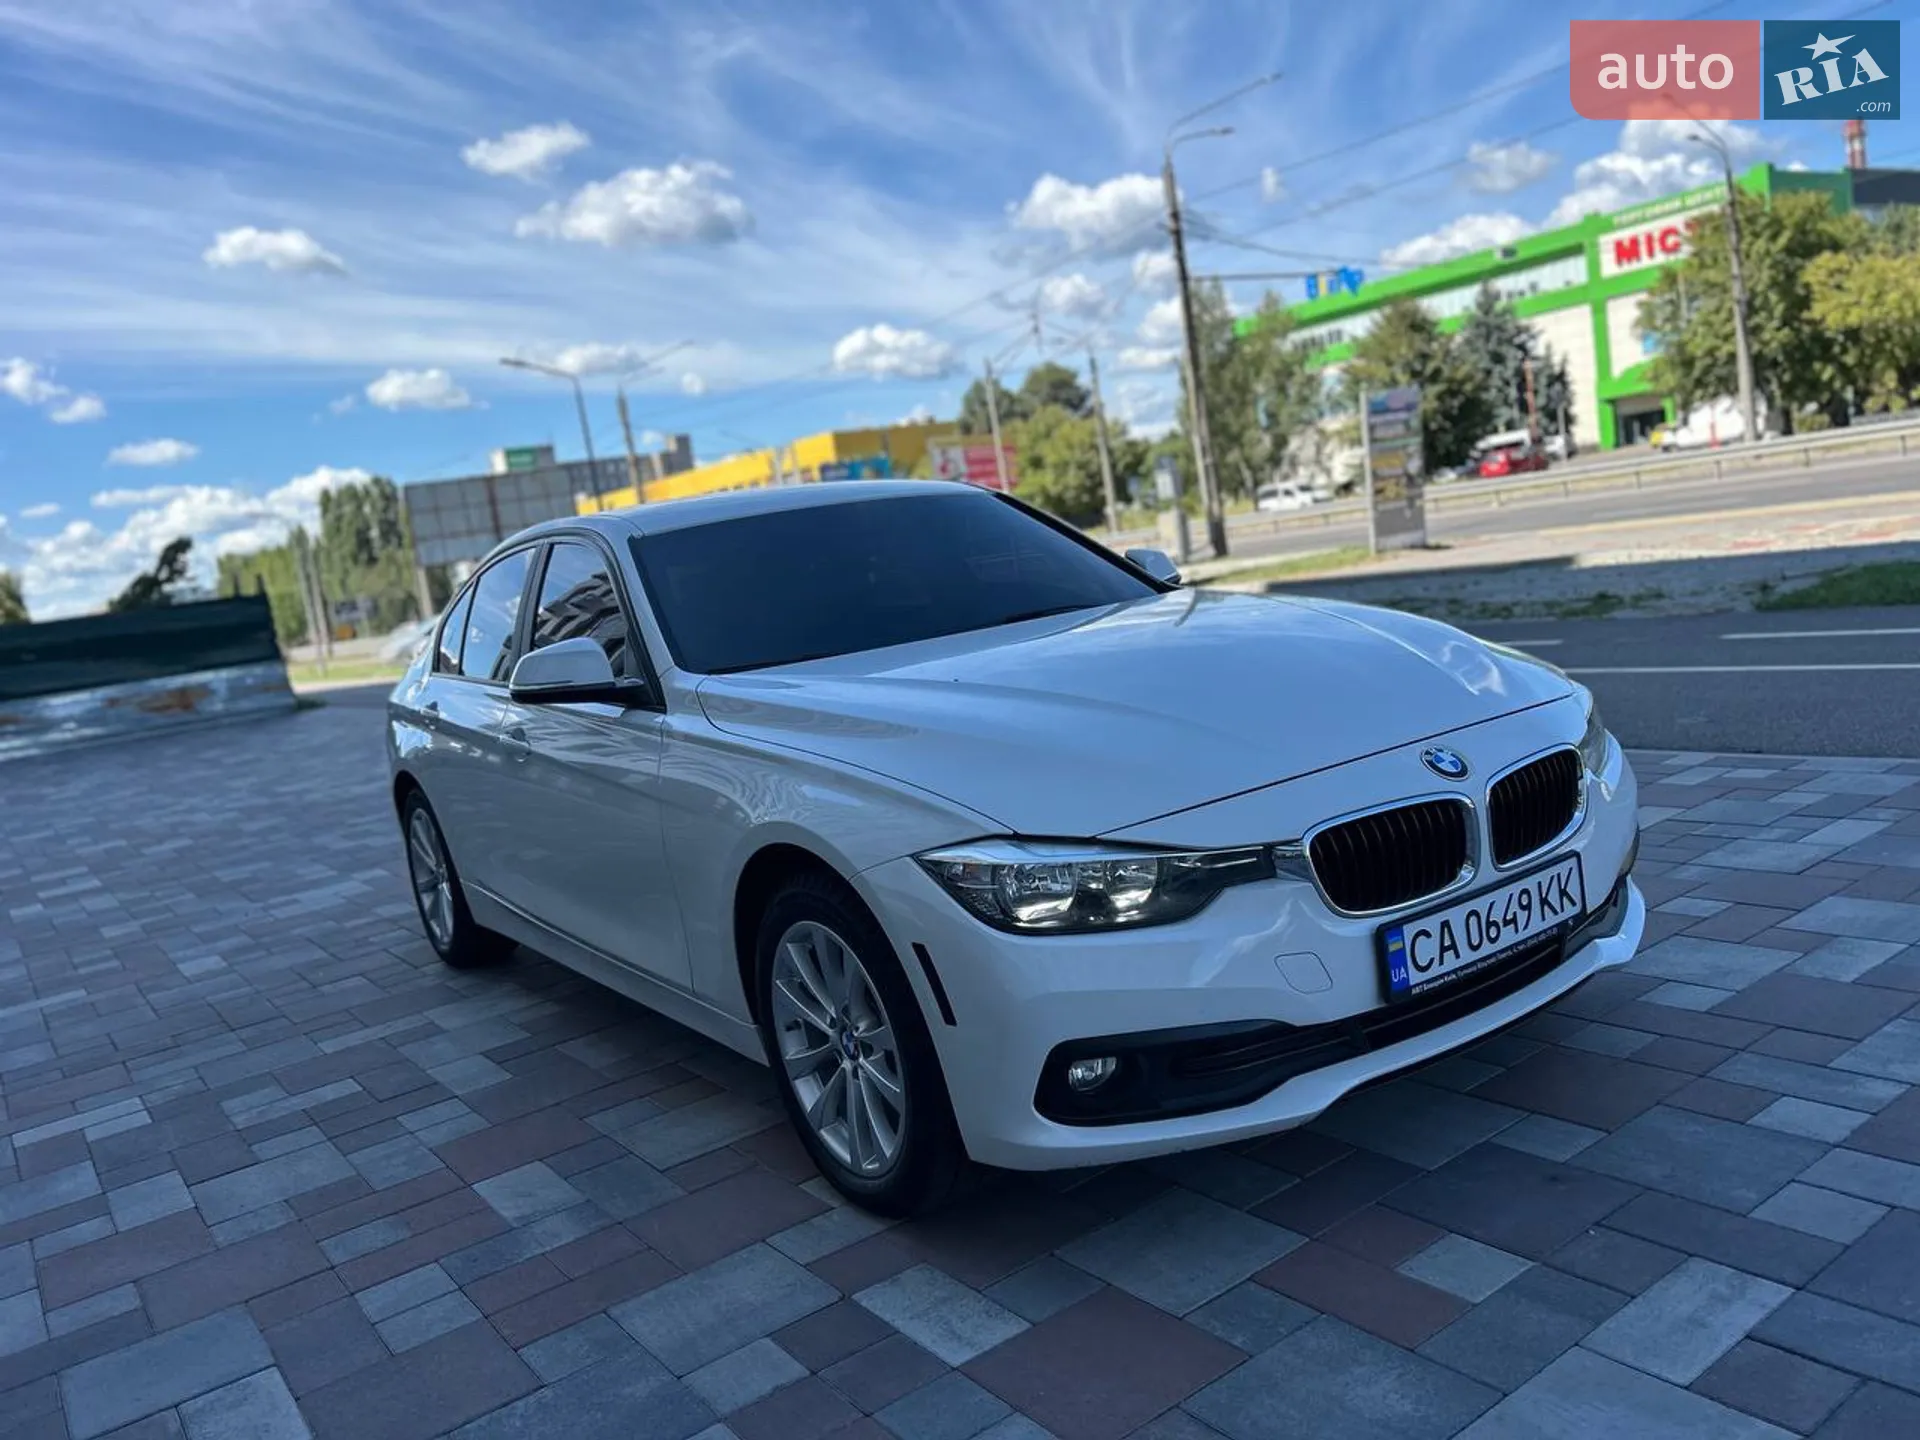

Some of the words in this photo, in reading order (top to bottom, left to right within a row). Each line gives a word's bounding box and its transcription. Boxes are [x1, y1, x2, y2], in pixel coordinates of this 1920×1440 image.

[1410, 920, 1460, 973] CA
[1465, 888, 1532, 952] 0649
[1537, 867, 1577, 922] KK
[1392, 968, 1408, 983] UA
